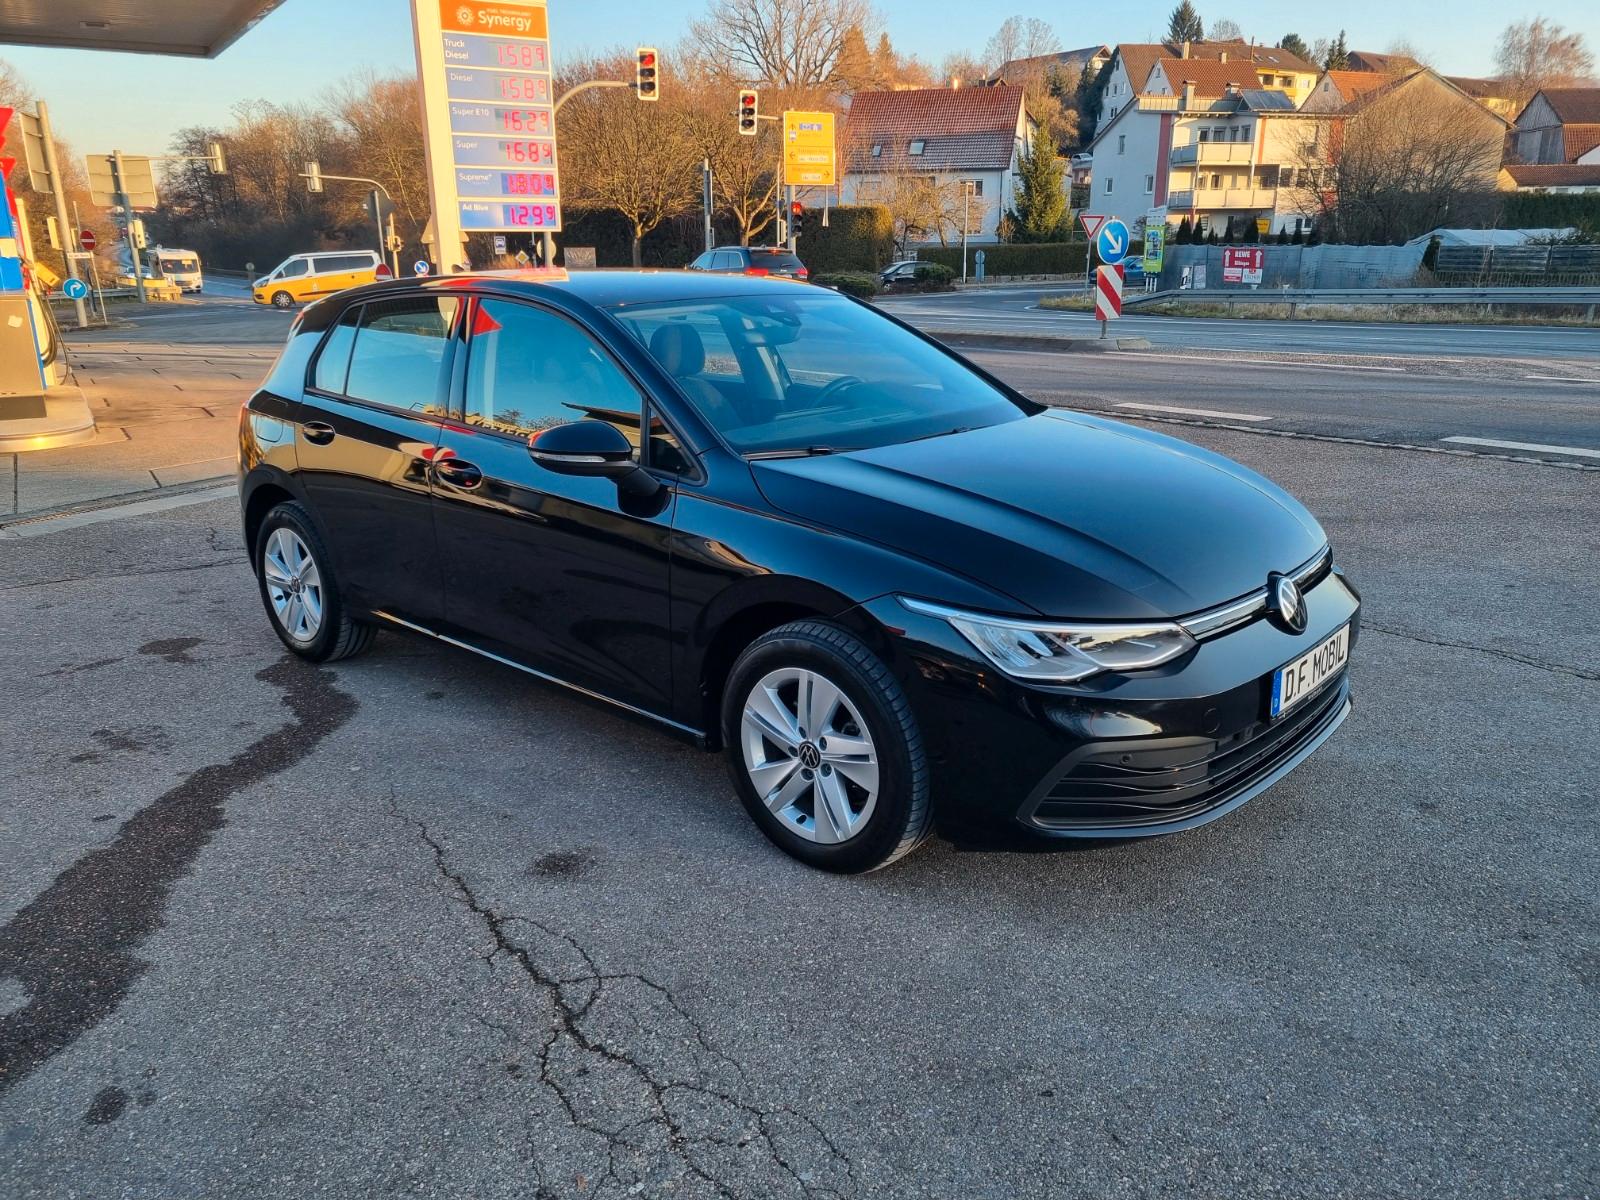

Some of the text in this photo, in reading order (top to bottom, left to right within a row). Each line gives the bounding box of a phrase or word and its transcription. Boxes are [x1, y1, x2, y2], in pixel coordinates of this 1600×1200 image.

[478, 10, 532, 32] Synergy
[444, 38, 465, 48] Truck
[445, 50, 469, 60] Diesel
[450, 72, 473, 82] Diesel
[452, 106, 490, 117] Super E10
[456, 140, 478, 150] Super
[1234, 250, 1251, 258] REWE
